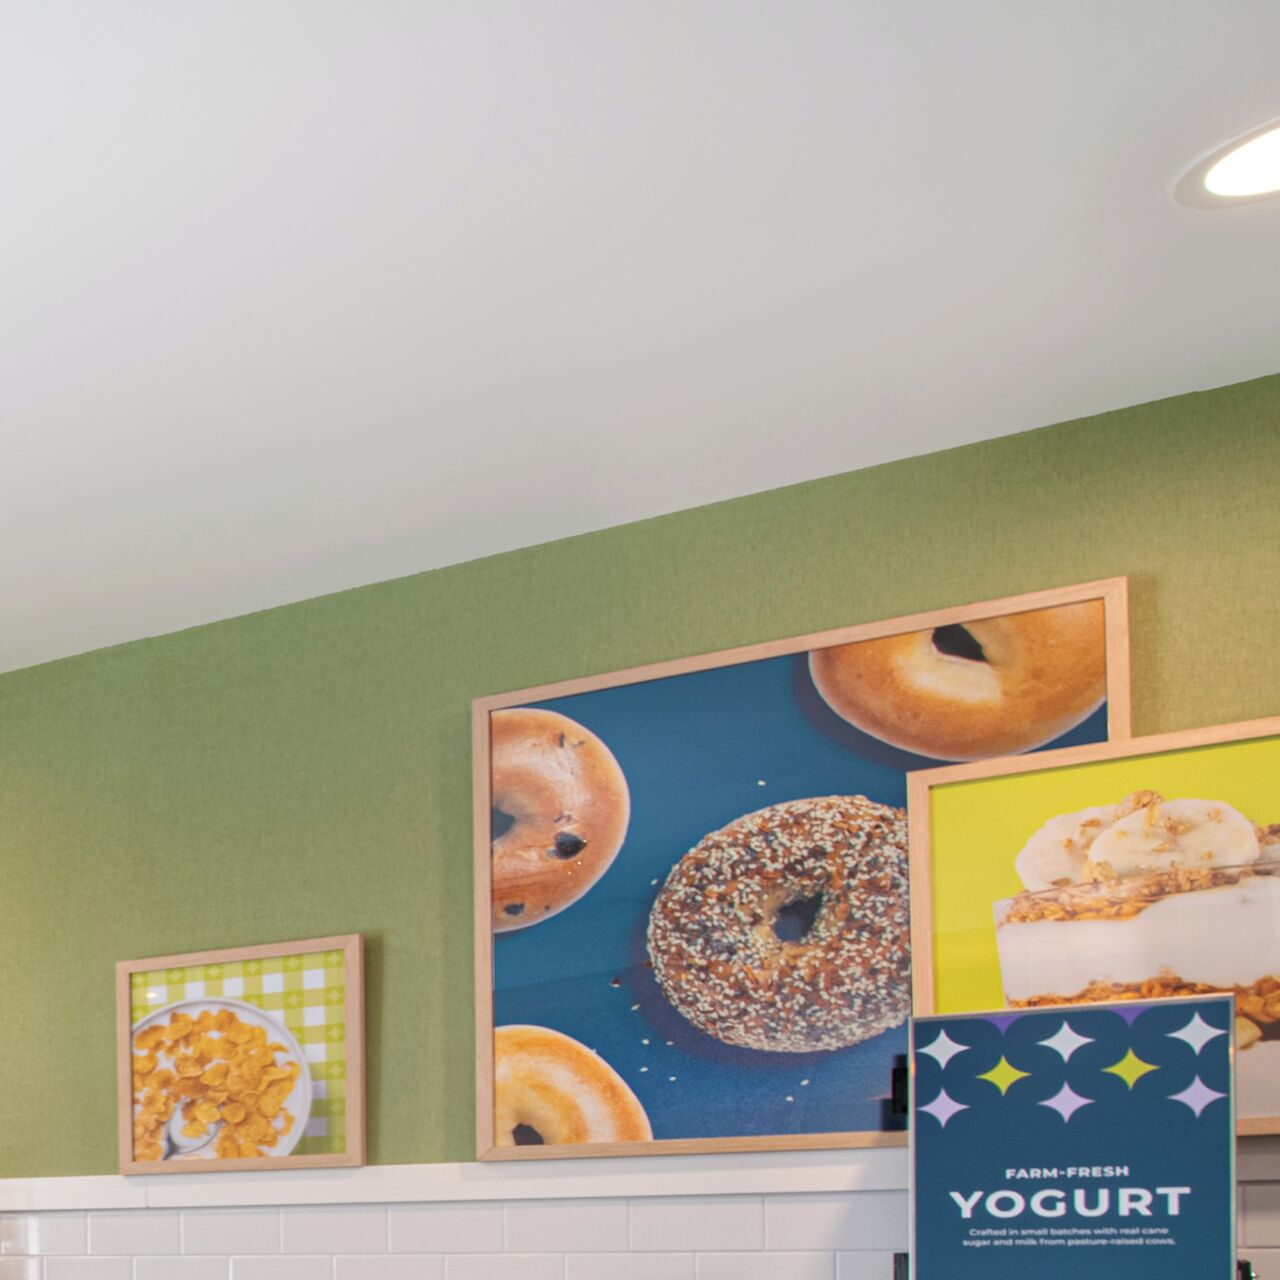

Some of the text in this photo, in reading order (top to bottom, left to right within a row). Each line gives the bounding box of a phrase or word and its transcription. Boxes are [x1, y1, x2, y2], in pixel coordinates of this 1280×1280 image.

[1005, 1165, 1129, 1180] FARM-FRESH
[948, 1186, 1192, 1219] YOGURT
[968, 1227, 1169, 1236] Crafted in small batches with real cane
[962, 1237, 1176, 1247] sugar and milk from pasture-raised cows.
